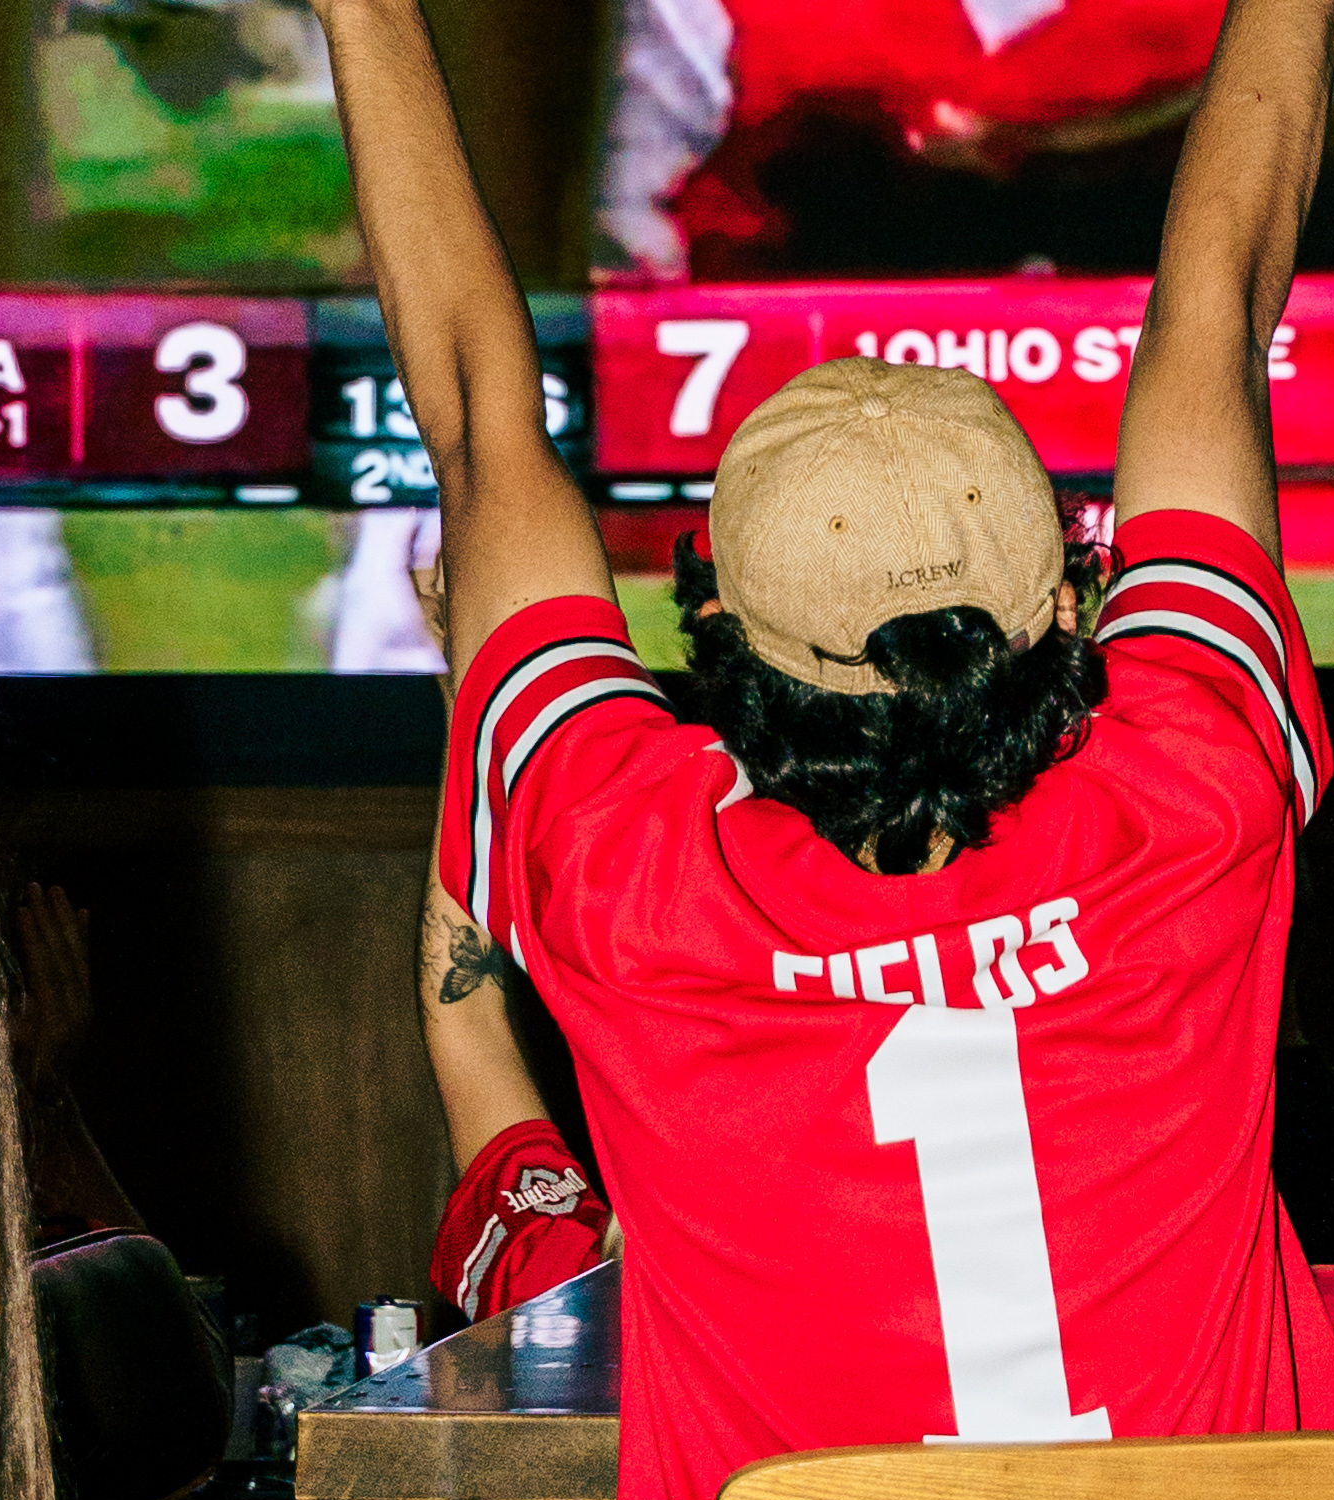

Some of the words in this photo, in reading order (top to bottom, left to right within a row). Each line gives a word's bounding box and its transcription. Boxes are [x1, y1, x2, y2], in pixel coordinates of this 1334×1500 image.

[153, 320, 250, 445] 3
[655, 318, 750, 438] 7
[883, 328, 1062, 384] OHIO
[1071, 325, 1298, 384] STE
[772, 896, 1090, 1010] FIELDS
[866, 1003, 1113, 1445] 1
